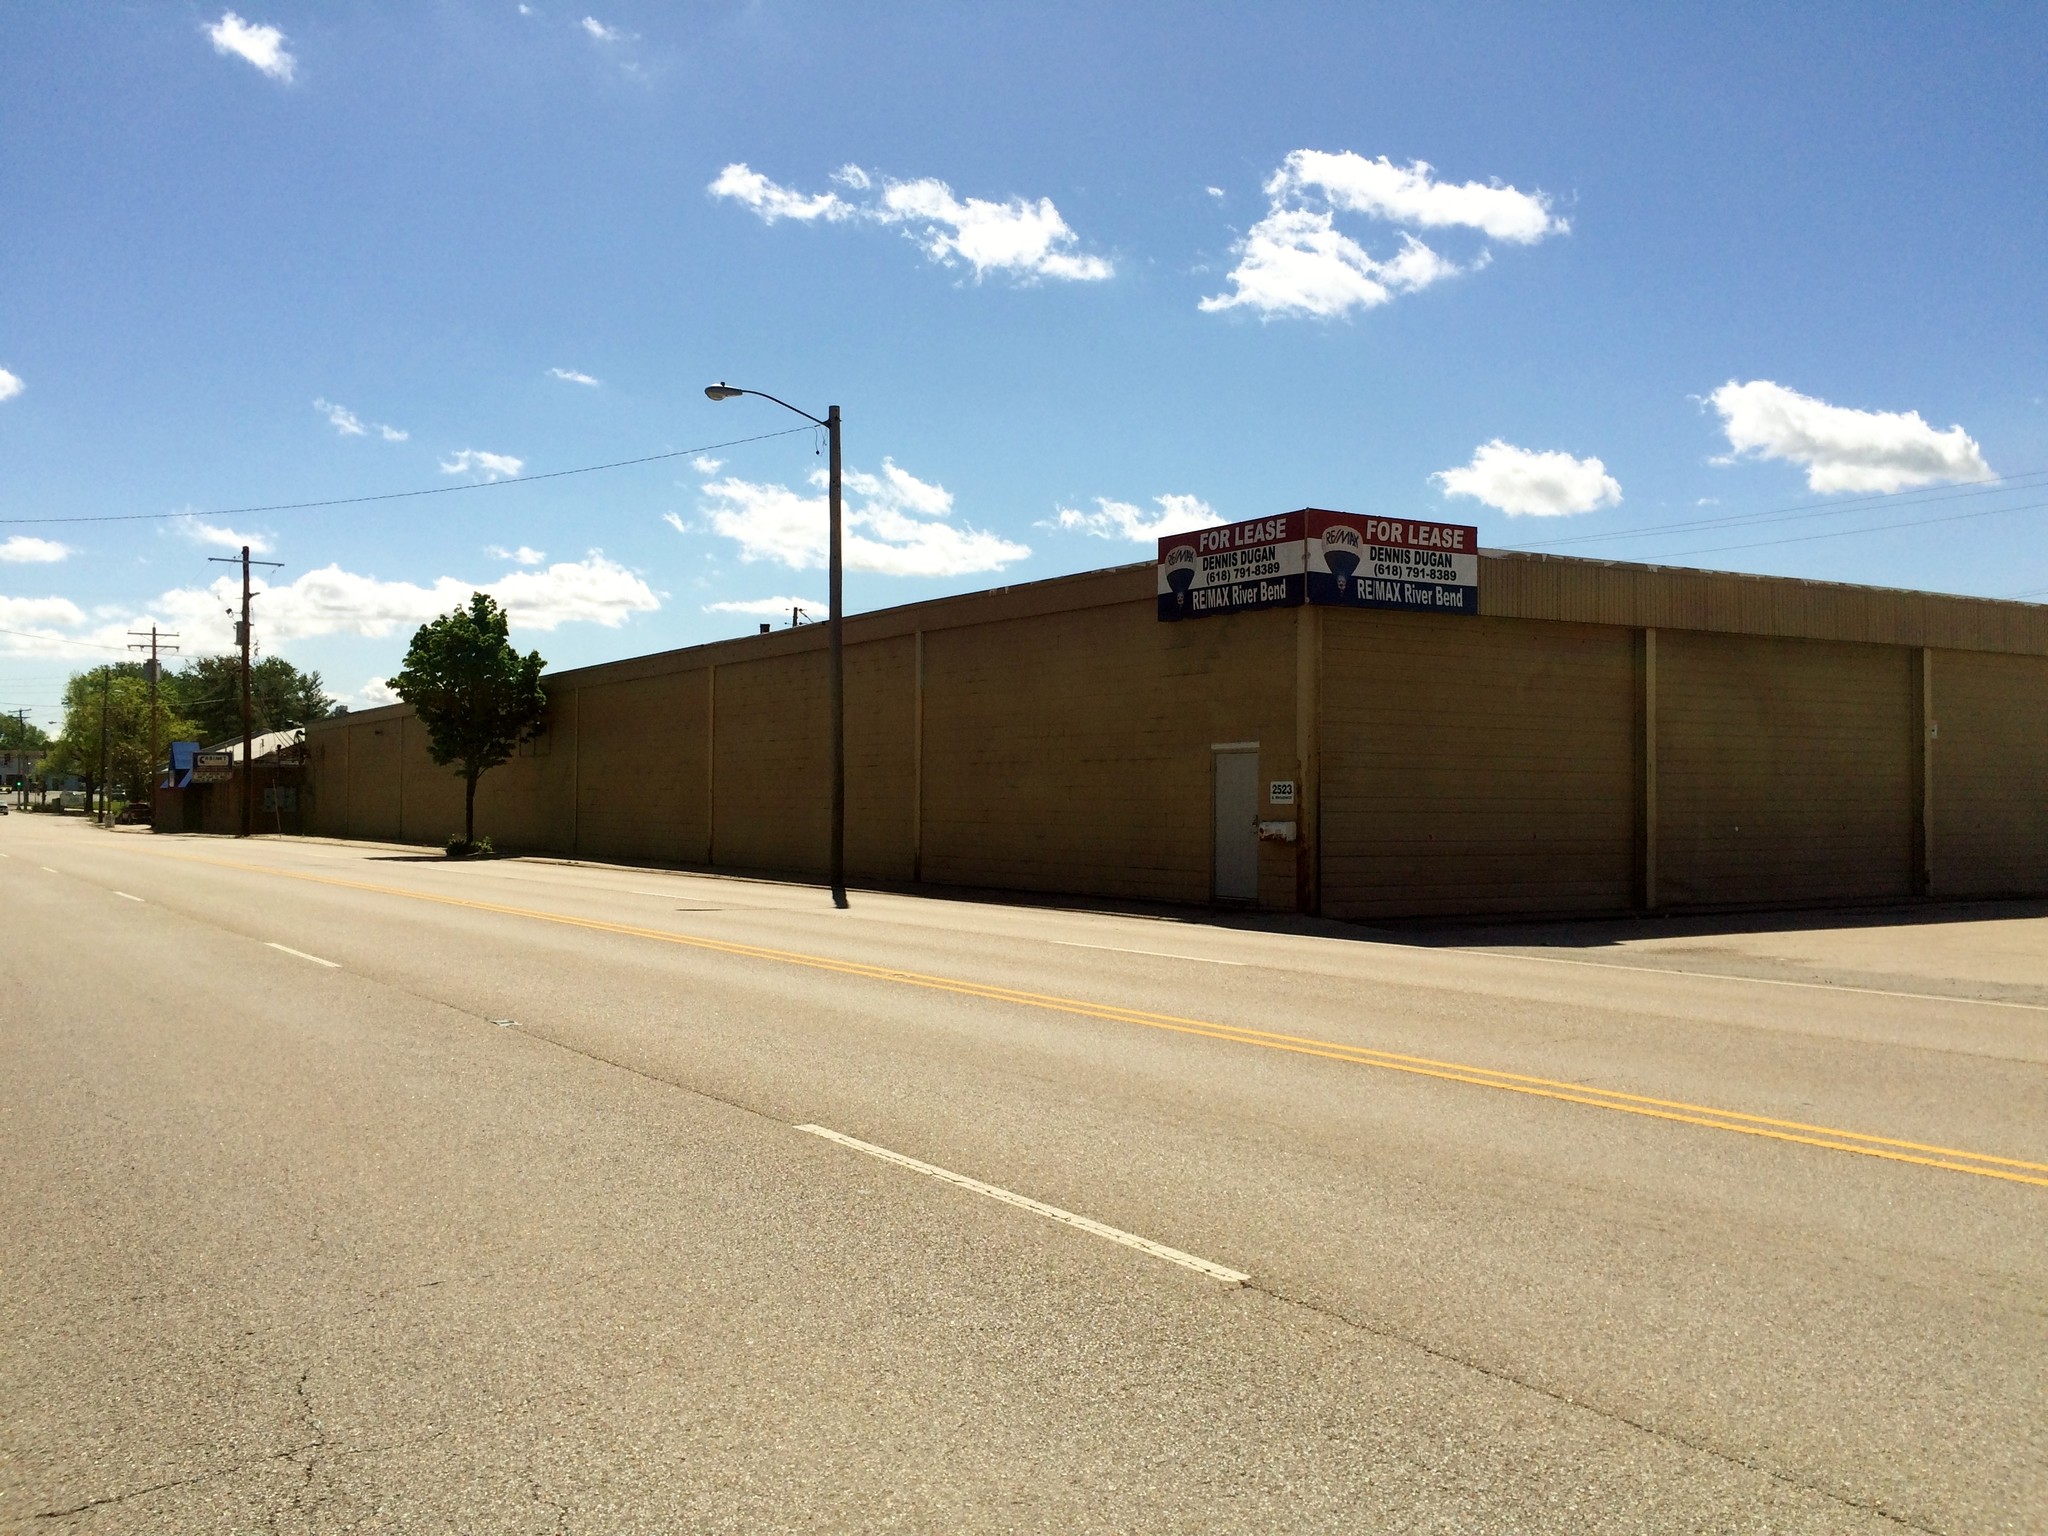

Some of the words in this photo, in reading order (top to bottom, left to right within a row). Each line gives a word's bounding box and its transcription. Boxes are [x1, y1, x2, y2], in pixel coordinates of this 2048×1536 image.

[1200, 529, 1230, 552] FOR
[1235, 518, 1287, 546] LEASE
[1326, 529, 1360, 548] RE/MAX
[1366, 520, 1403, 543] FOR
[1408, 525, 1464, 549] LEASE
[1168, 549, 1194, 566] RE/MAX
[1203, 552, 1238, 571] DENNIS
[1240, 546, 1276, 565] DUGAN
[1370, 546, 1411, 564] DENNIS
[1414, 551, 1452, 568] DUGAN
[1206, 569, 1231, 585] (618)
[1234, 562, 1280, 579] 791-8389
[1373, 563, 1403, 578] (618)
[1406, 567, 1457, 581] 791-8389
[1192, 587, 1230, 610] RE/MAX
[1232, 585, 1258, 605] River
[1260, 579, 1286, 602] Bend
[1357, 579, 1402, 602] RE/MAX
[1404, 584, 1433, 605] River
[1436, 586, 1463, 607] Bend
[1272, 784, 1292, 795] 2523
